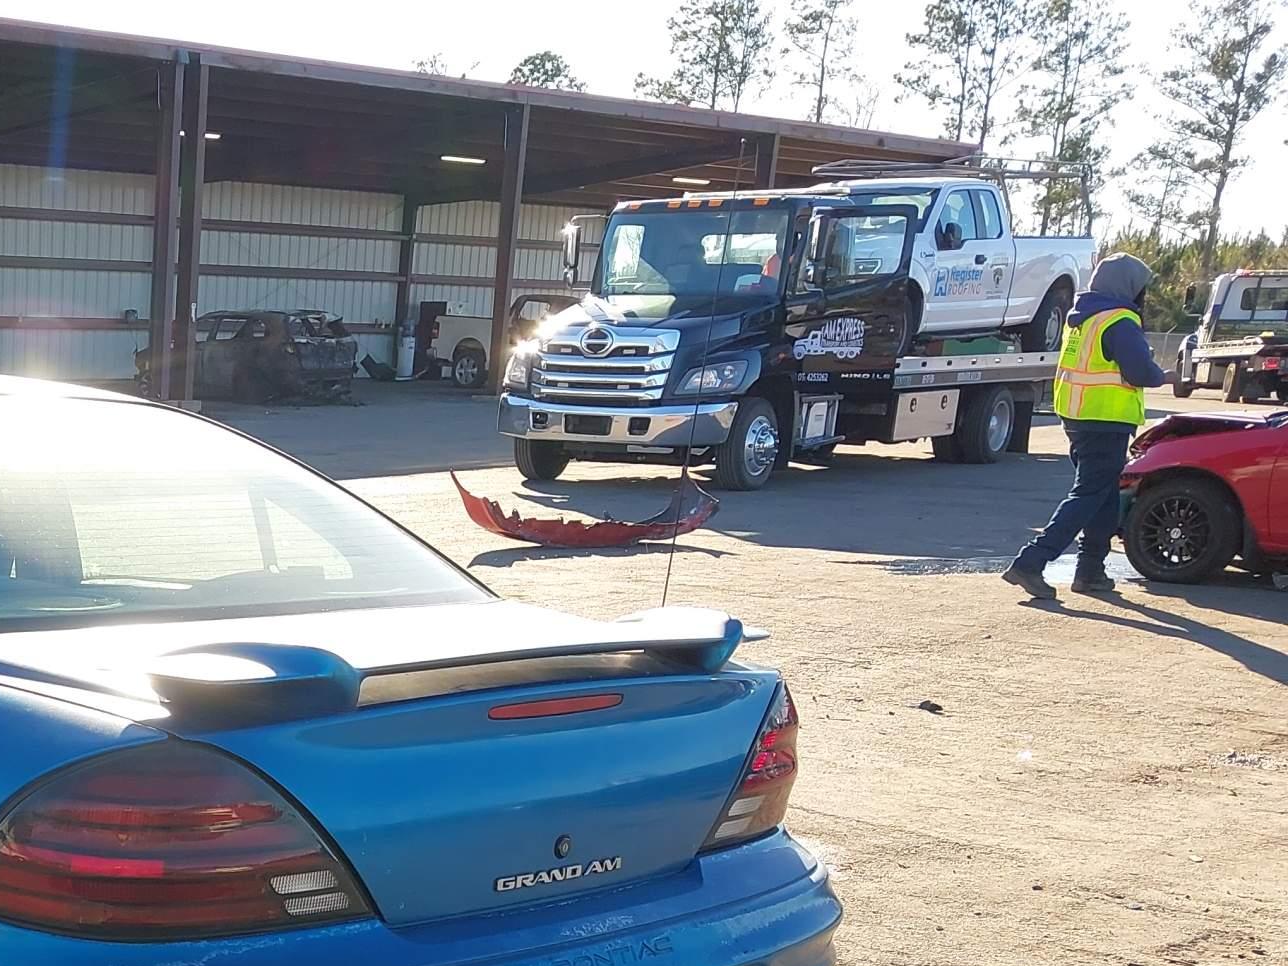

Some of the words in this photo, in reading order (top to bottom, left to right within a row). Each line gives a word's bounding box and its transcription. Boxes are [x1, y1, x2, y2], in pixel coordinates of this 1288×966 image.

[951, 266, 983, 283] Register
[948, 282, 982, 296] ROOFING
[835, 317, 865, 341] EXPRESS
[496, 864, 582, 891] GRAND
[584, 857, 622, 876] AM
